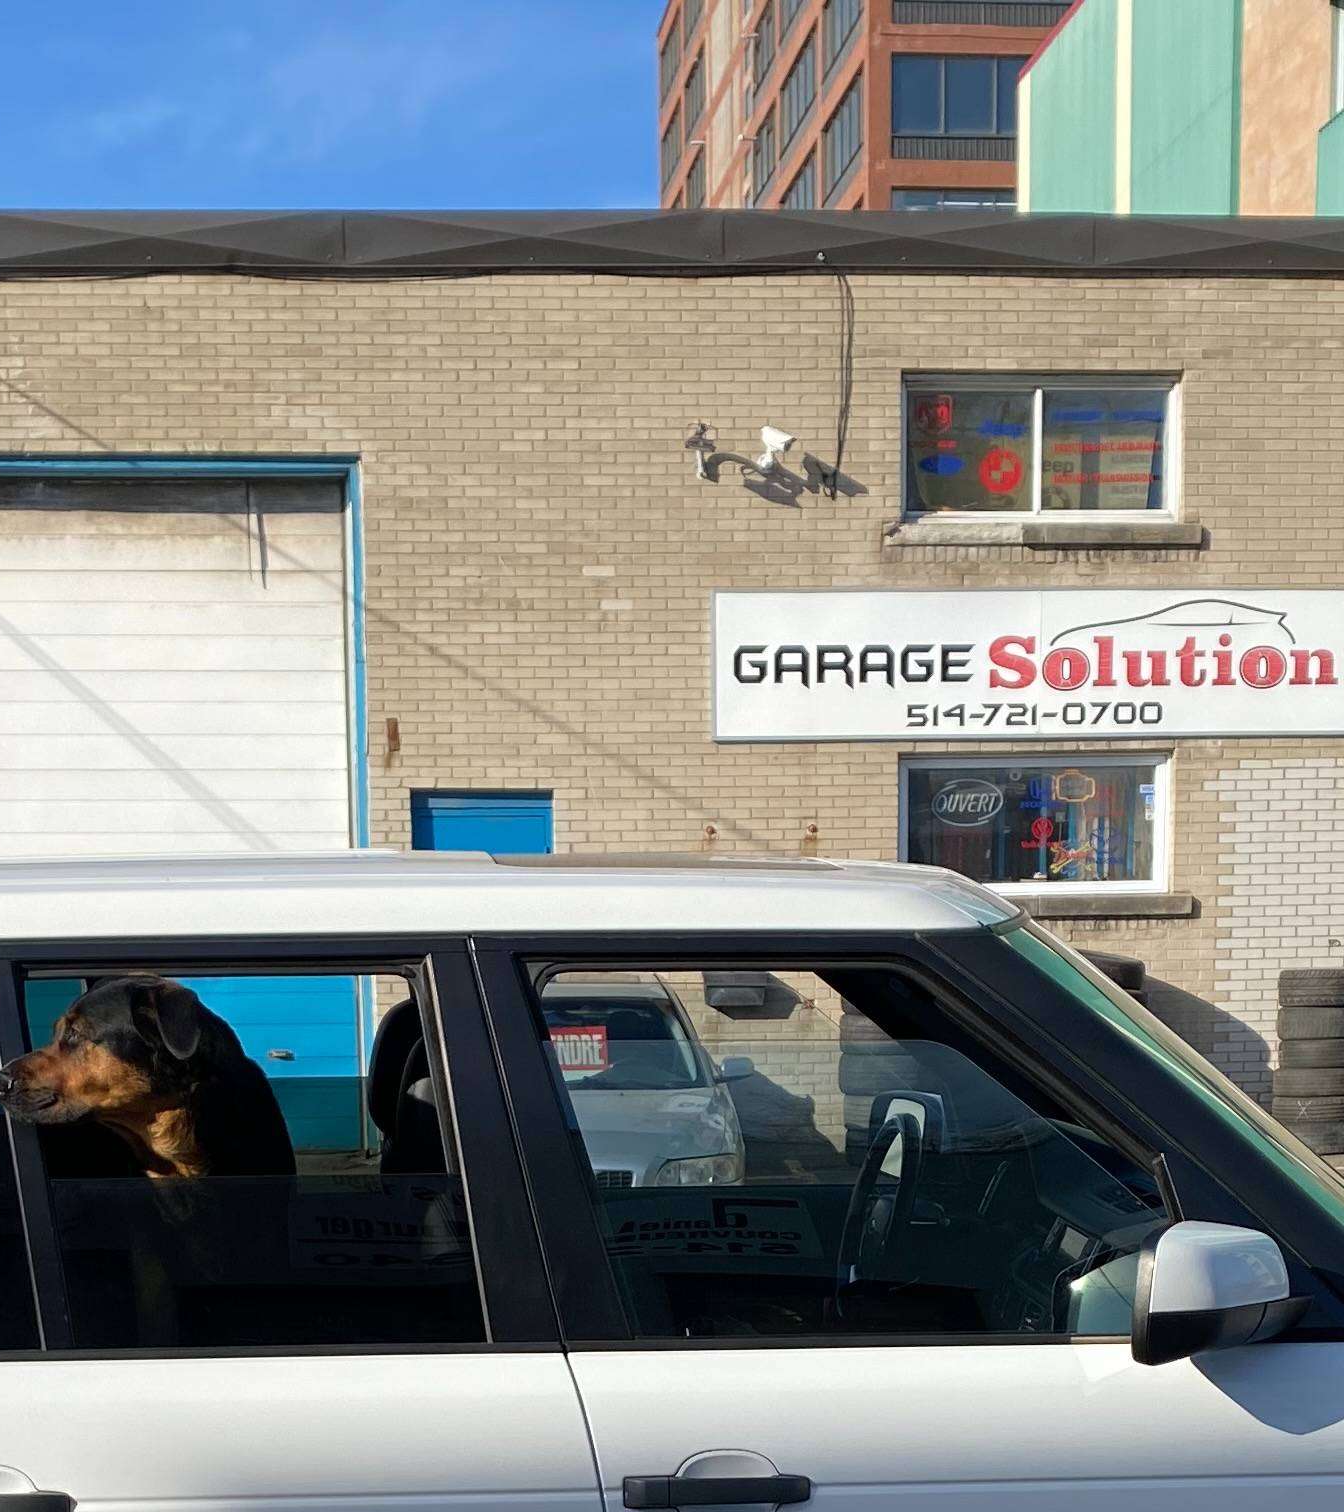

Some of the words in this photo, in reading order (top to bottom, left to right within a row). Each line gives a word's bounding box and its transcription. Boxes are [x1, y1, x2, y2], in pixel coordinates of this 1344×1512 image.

[733, 643, 975, 690] GARAGE
[987, 632, 1339, 691] Solution
[906, 702, 1163, 727] 514-721-0700
[936, 792, 998, 813] OUVERT
[551, 1033, 605, 1065] NDRE
